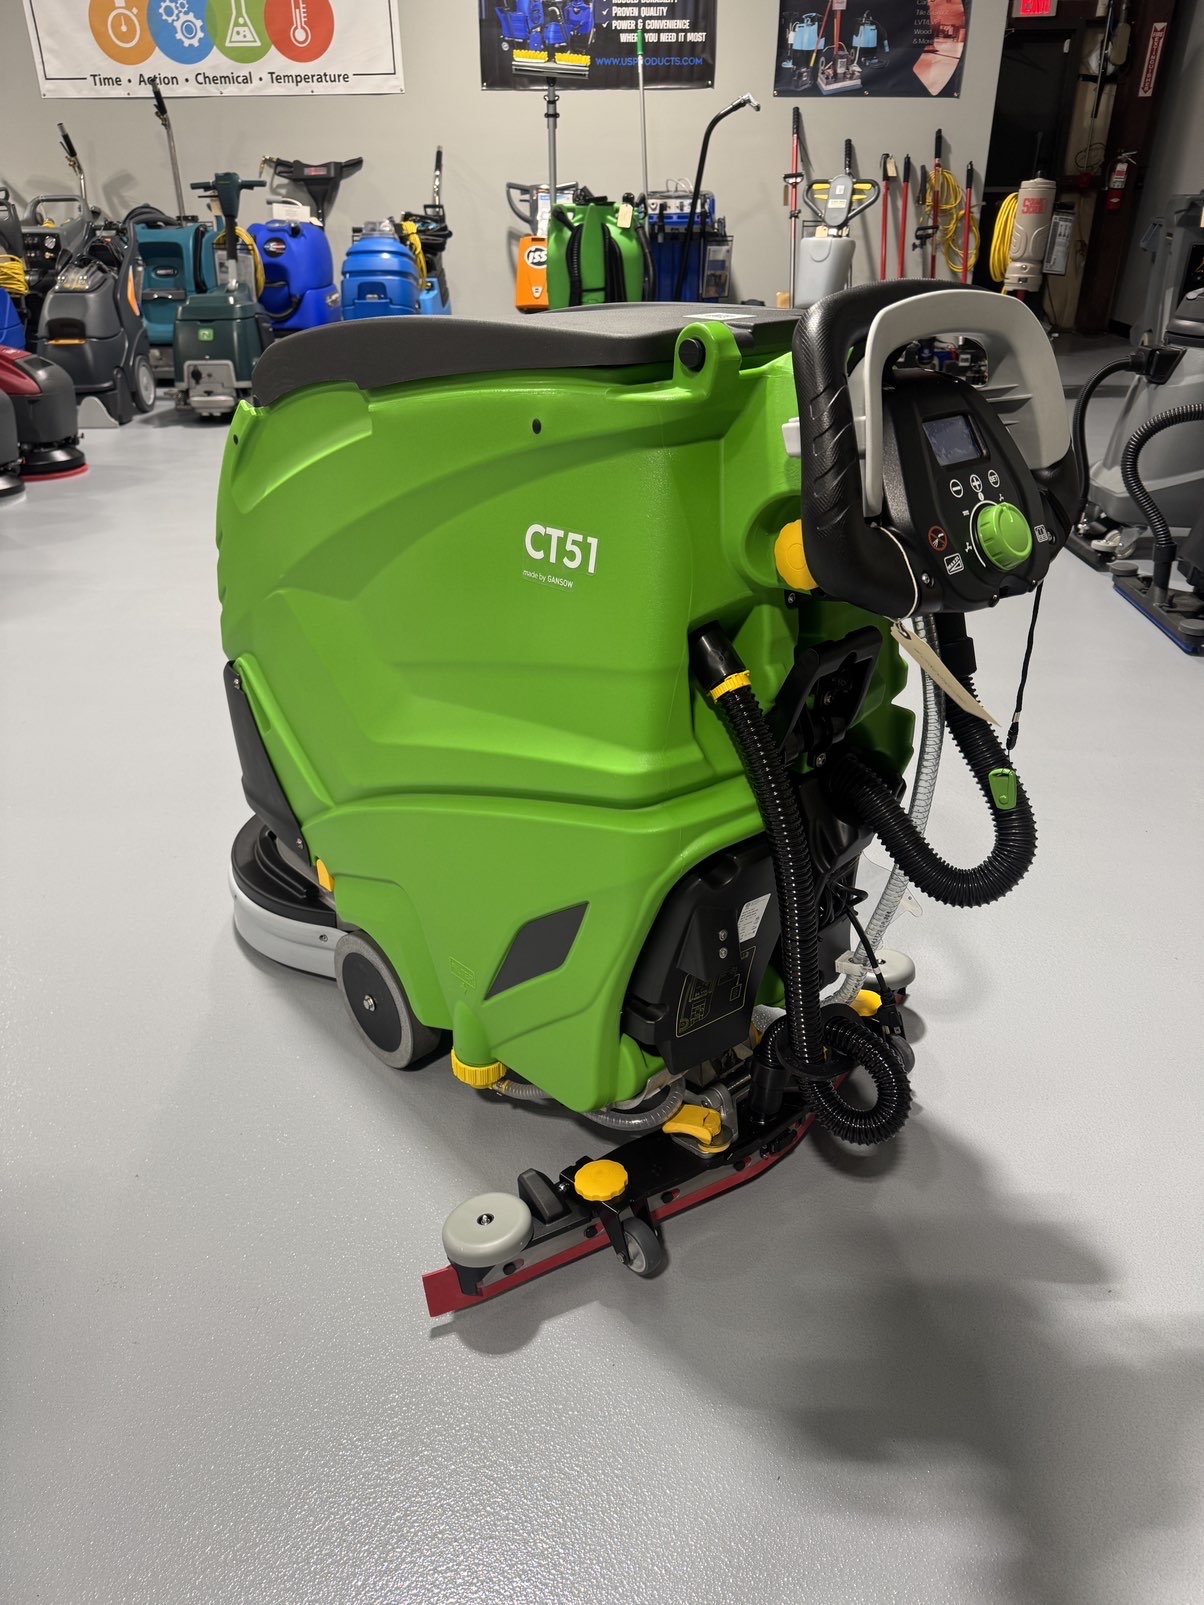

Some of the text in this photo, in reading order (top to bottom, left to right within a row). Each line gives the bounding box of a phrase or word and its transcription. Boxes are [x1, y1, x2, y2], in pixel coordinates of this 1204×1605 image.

[612, 6, 668, 17] PROVEN QUALITY
[612, 19, 690, 30] POWER & CONVENIENCE
[644, 32, 658, 42] YOU
[659, 32, 677, 42] NEED
[678, 32, 685, 42] IT
[687, 32, 707, 42] MOST
[595, 57, 703, 66] WWW.USPODUCTS.COM
[90, 71, 350, 87] Time Action Chemical Temperature
[525, 523, 599, 574] CT51
[523, 570, 574, 588] made by GANSOW
